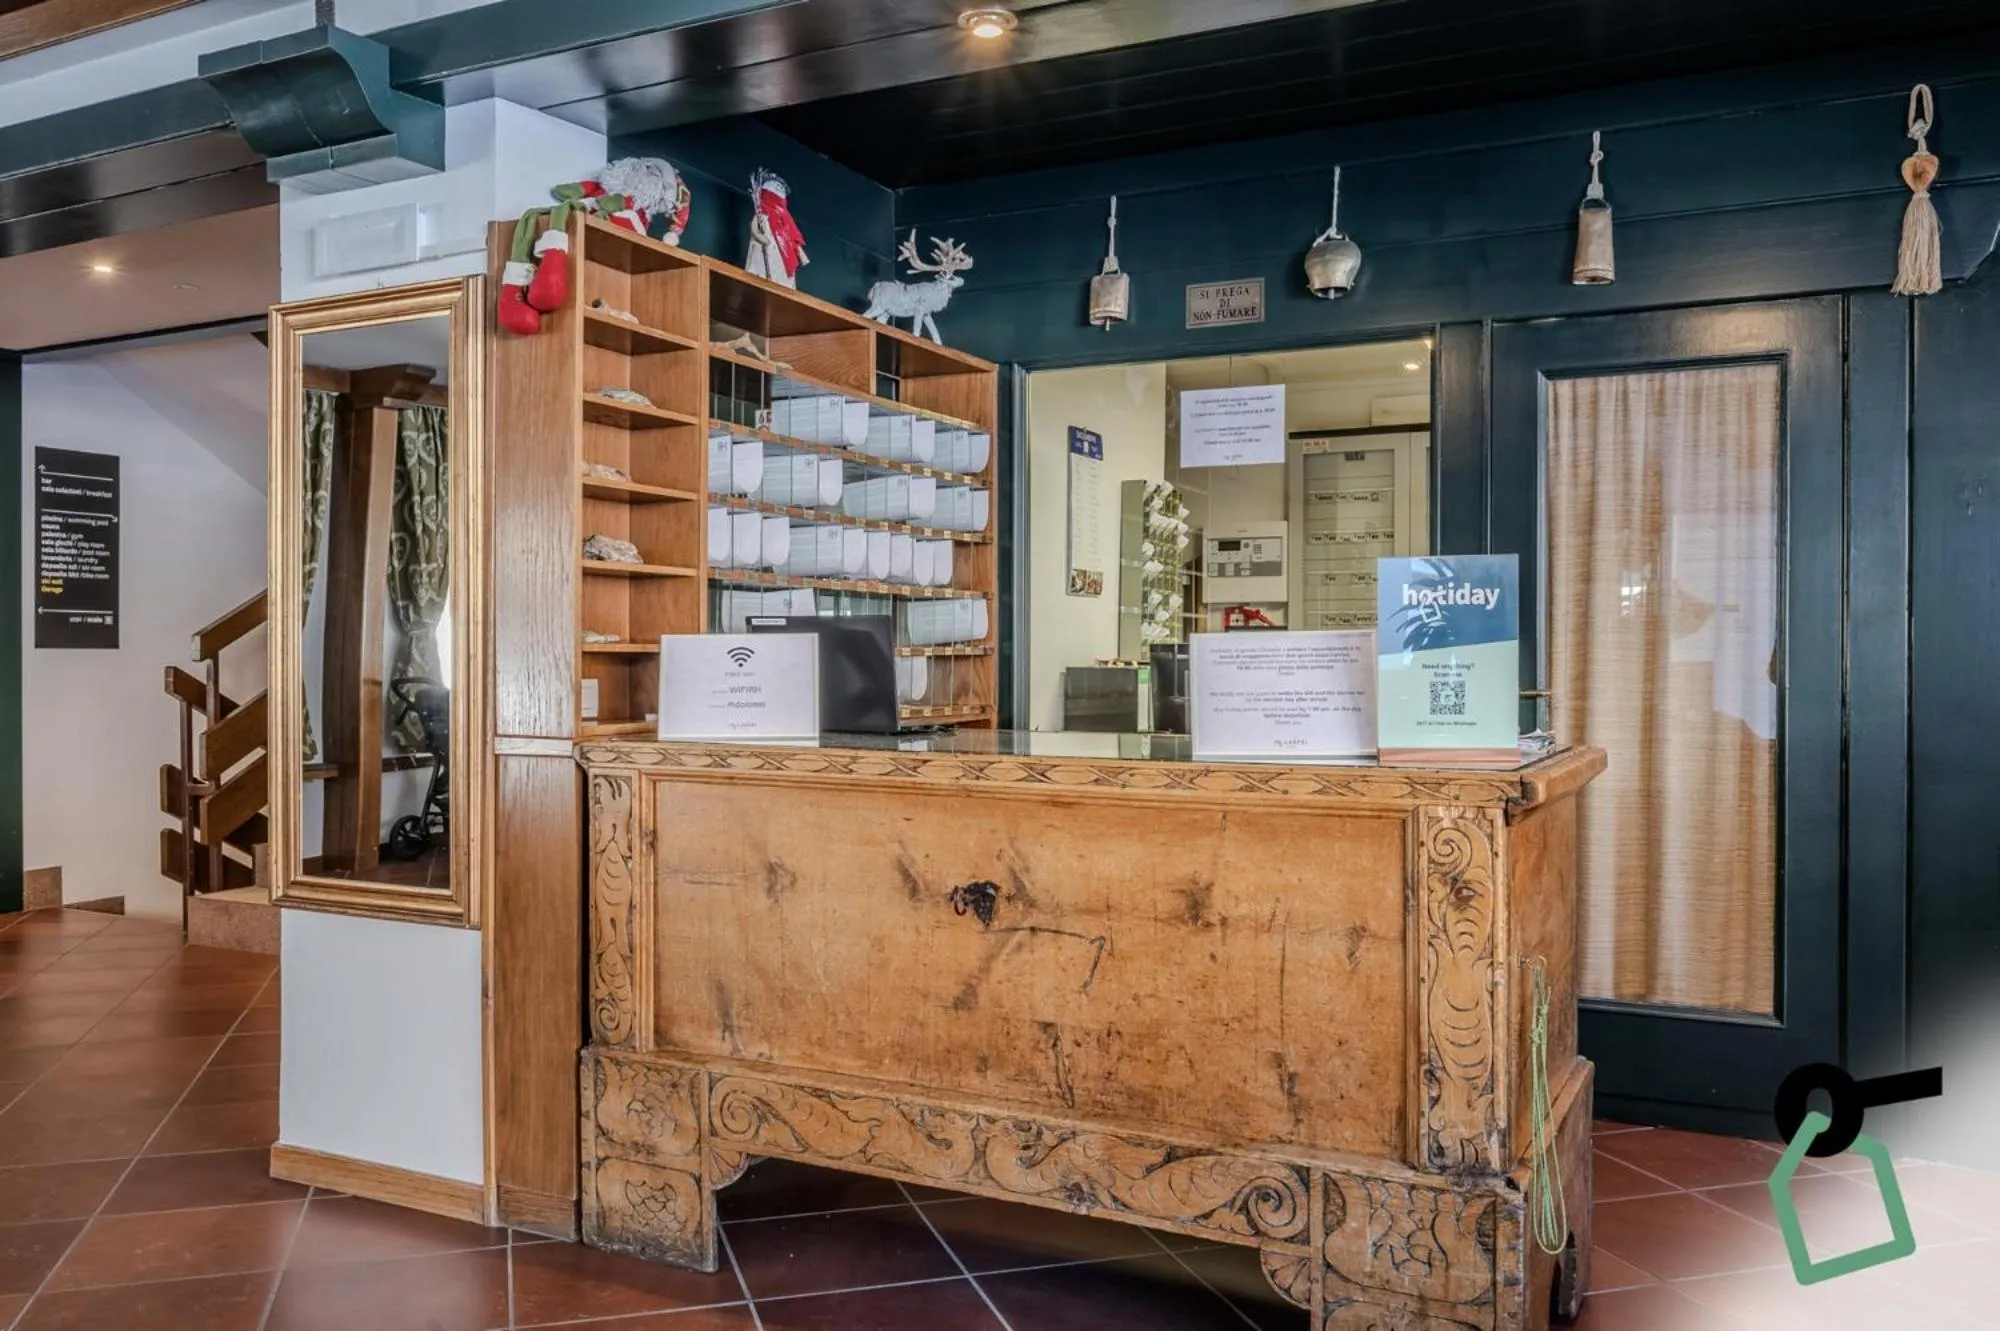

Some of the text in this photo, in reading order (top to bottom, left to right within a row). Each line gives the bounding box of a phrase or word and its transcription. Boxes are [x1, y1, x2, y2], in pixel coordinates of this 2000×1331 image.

[1199, 286, 1250, 299] SI PREGA
[1219, 298, 1230, 308] DI
[1193, 306, 1257, 322] NON FUMARE
[1402, 582, 1500, 610] hotiday
[1441, 662, 1475, 671] anyhing?
